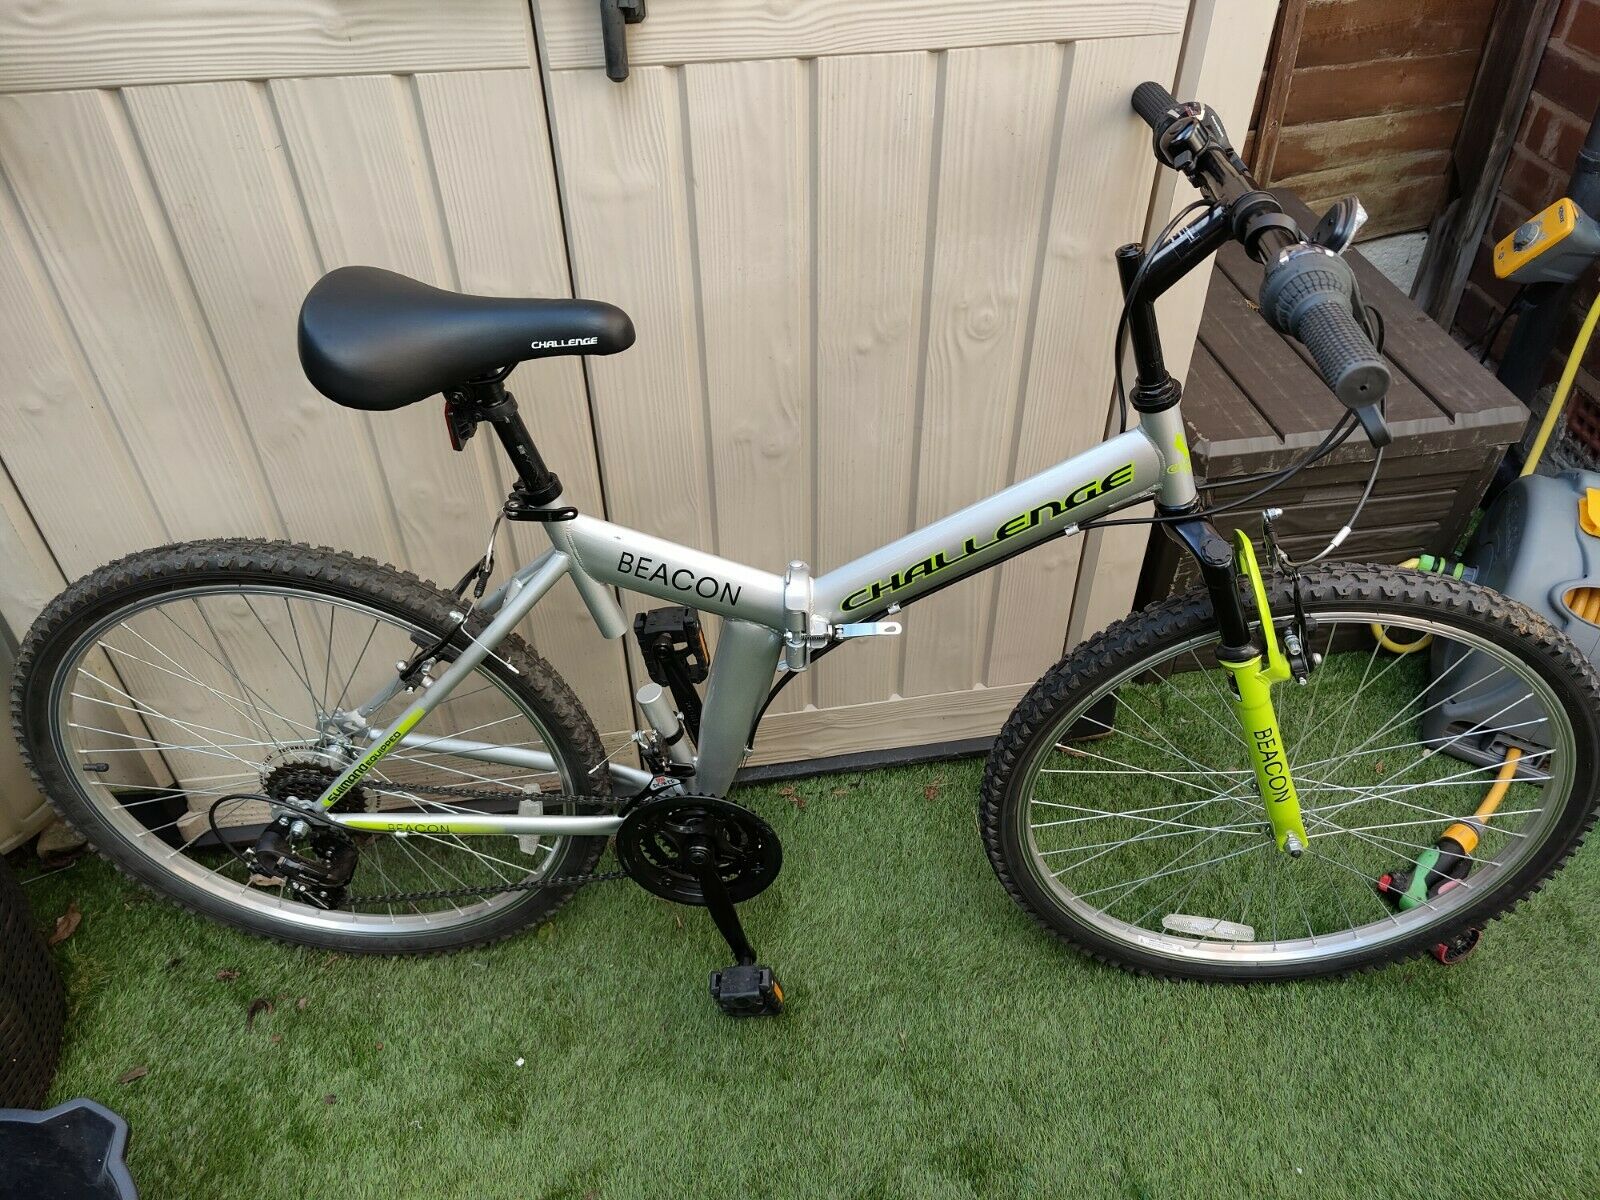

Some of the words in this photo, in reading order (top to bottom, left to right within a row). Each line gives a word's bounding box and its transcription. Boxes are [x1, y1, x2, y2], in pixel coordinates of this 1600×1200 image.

[531, 337, 598, 349] CHALLENGE
[839, 461, 1136, 612] CHALLENGE
[617, 551, 742, 606] BEACON
[365, 731, 402, 766] EQUIPPED
[1254, 728, 1291, 803] BEACON
